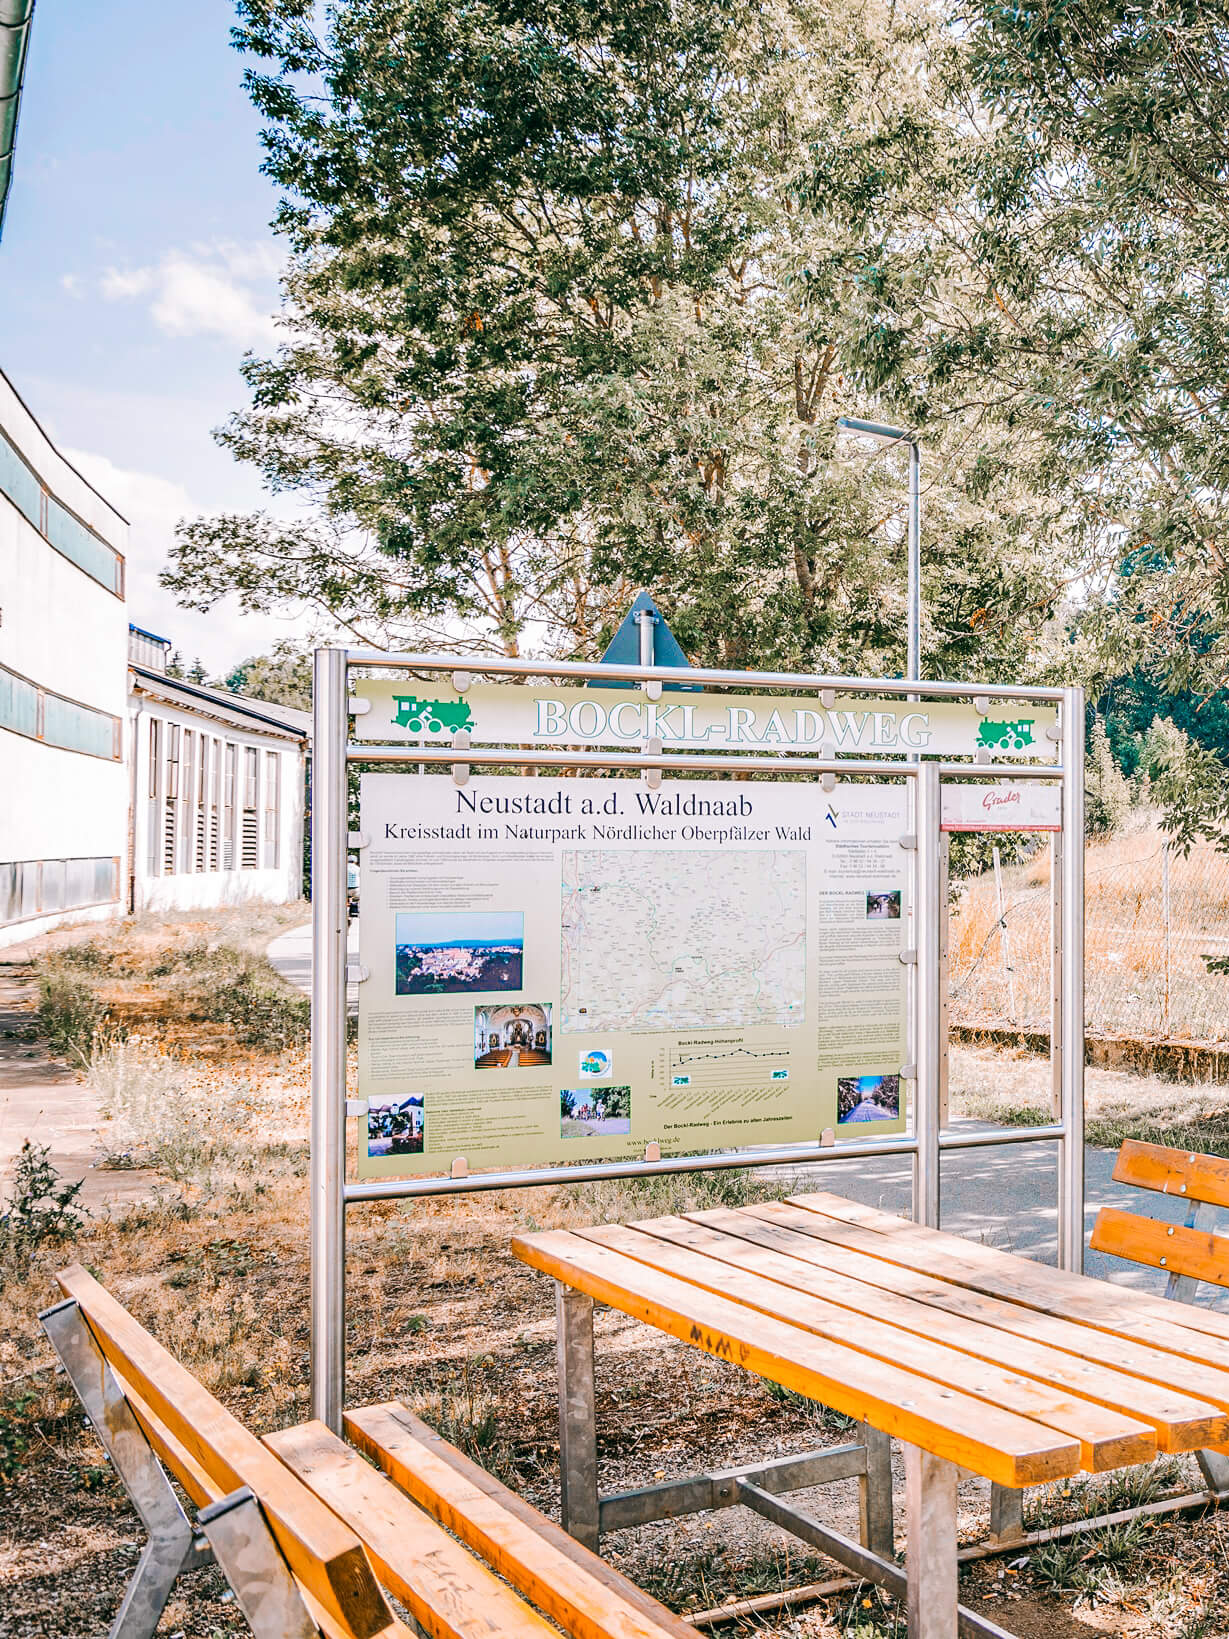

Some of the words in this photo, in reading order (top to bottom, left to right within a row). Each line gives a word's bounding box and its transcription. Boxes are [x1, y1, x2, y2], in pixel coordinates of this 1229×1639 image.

[533, 698, 932, 749] BOCKL-RADWEG
[456, 789, 573, 815] Neustadt
[581, 791, 625, 816] a.d.
[636, 792, 753, 818] Waldnaab
[384, 822, 472, 840] Kreisstadt
[478, 824, 499, 840] im
[506, 824, 587, 844] Naturpark
[593, 824, 677, 841] Nördlicher
[681, 825, 770, 845] Oberpfälzer
[775, 826, 812, 842] Wald
